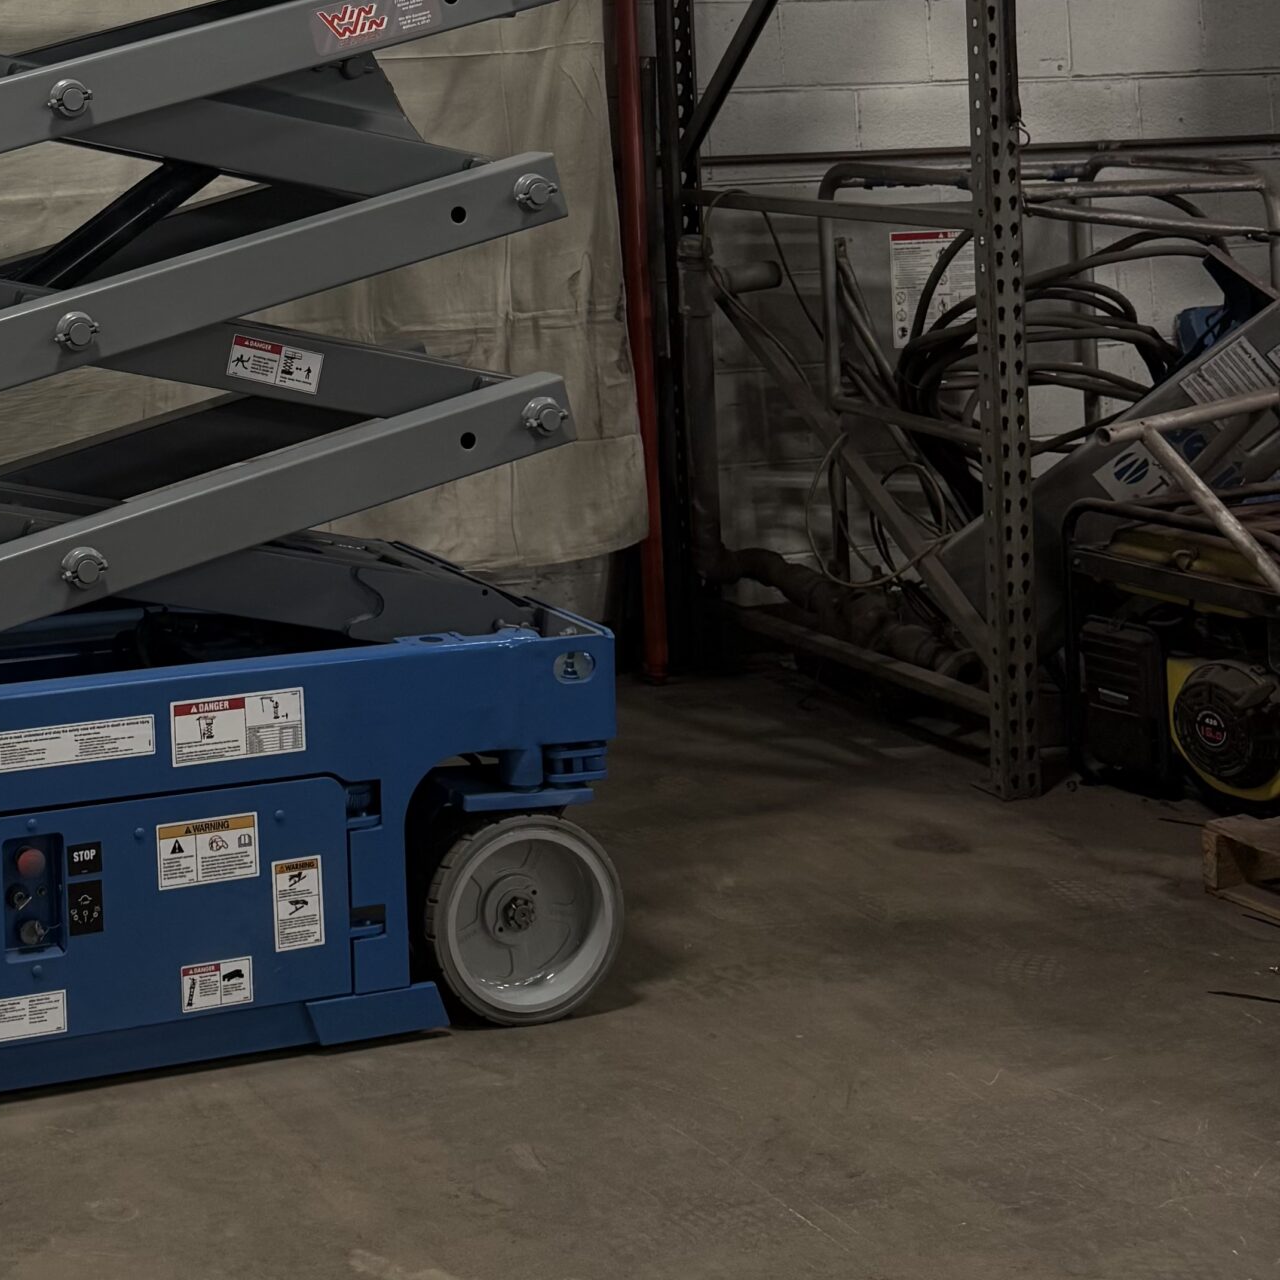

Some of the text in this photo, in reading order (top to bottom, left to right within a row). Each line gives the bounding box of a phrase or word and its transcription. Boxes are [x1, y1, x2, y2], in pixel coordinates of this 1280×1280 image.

[250, 340, 272, 351] DANGER
[199, 700, 229, 712] DANGER
[193, 820, 229, 832] WARNING
[73, 849, 96, 862] STOP
[285, 861, 314, 871] WARNING
[194, 965, 215, 974] DANGER
